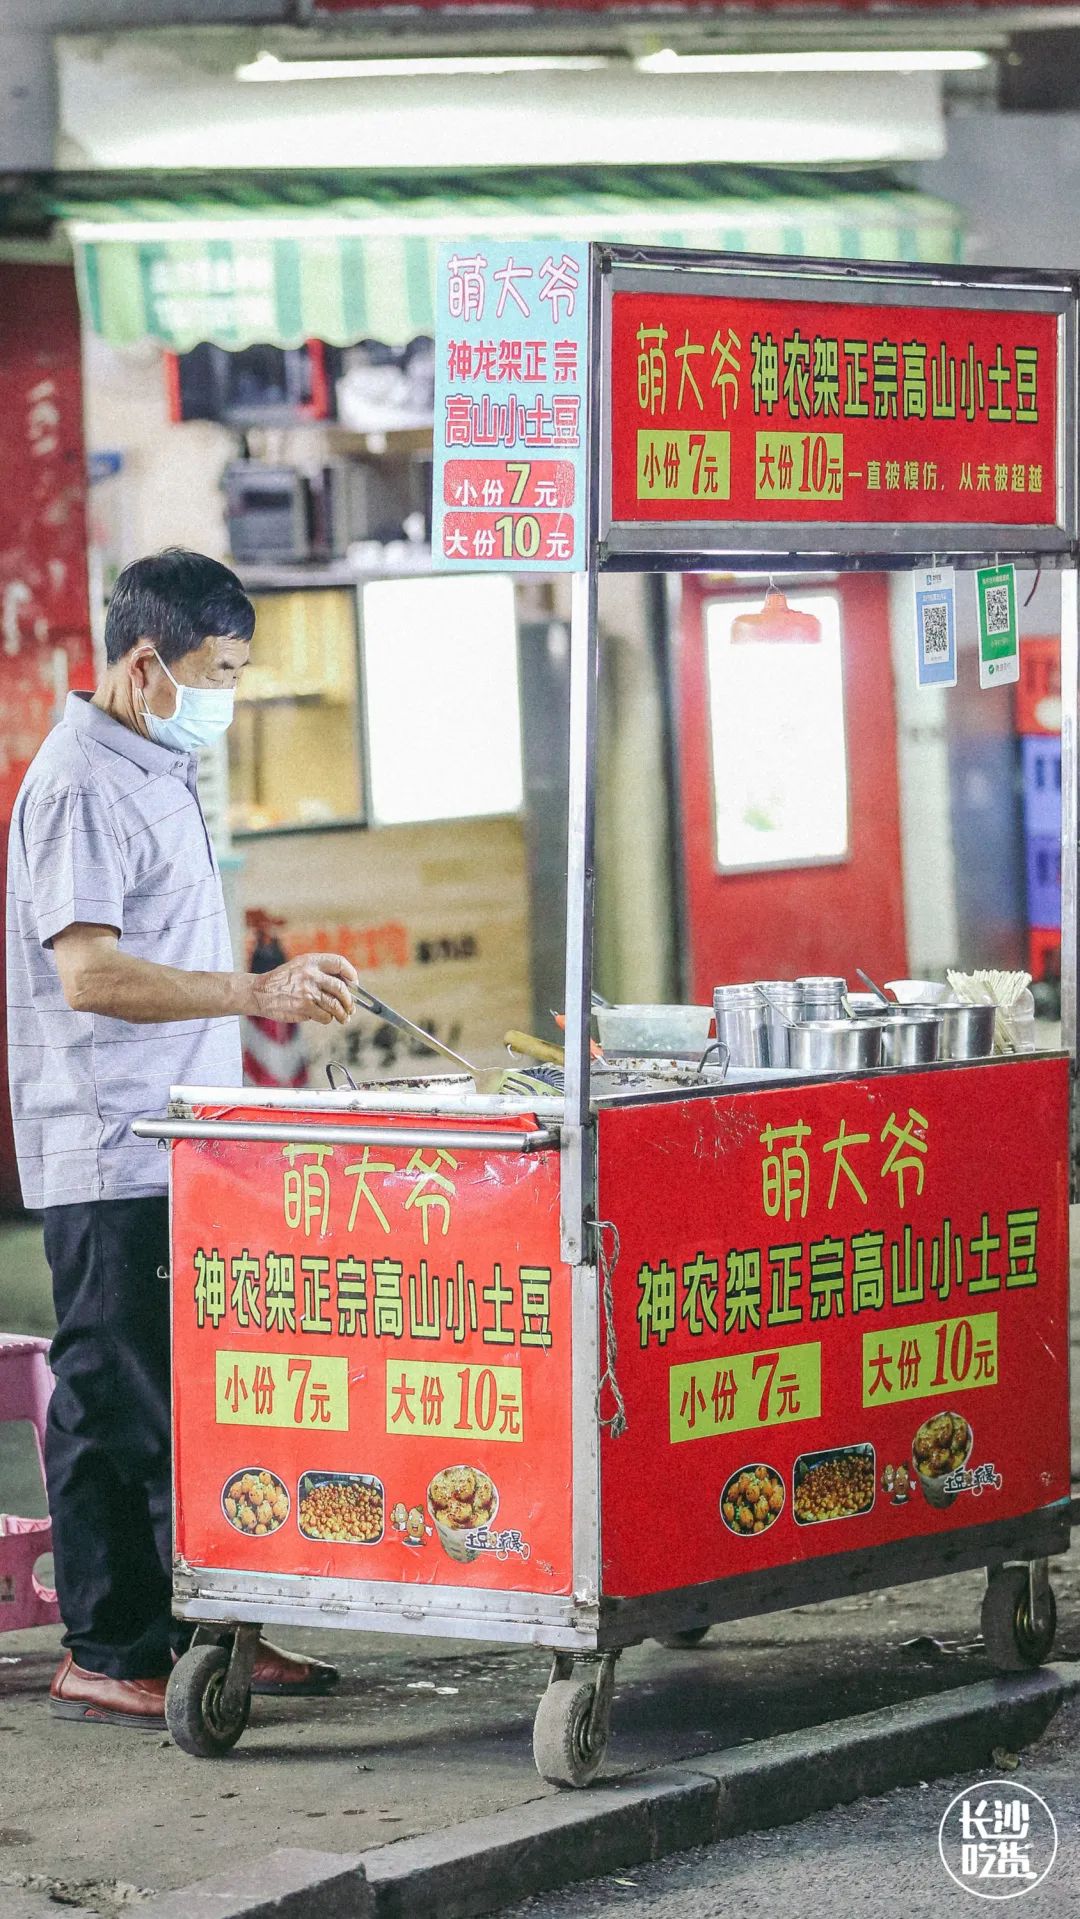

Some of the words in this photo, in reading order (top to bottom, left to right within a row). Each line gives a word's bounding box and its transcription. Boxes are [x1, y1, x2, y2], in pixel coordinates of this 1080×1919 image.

[448, 253, 580, 324] 萌大爷
[447, 339, 579, 382] 神龙架正宗
[636, 322, 741, 420] 萌大爷
[751, 328, 1039, 424] 神农架正宗高山小土豆
[445, 394, 580, 447] 高山小土豆
[455, 462, 558, 506] 小份7元
[445, 515, 570, 558] 大份10元
[282, 1143, 458, 1245] 萌大爷
[760, 1108, 930, 1222] 萌大爷
[193, 1247, 553, 1347] 神农架正宗高山小土豆
[636, 1209, 1040, 1348] 神农架正宗高山小土豆
